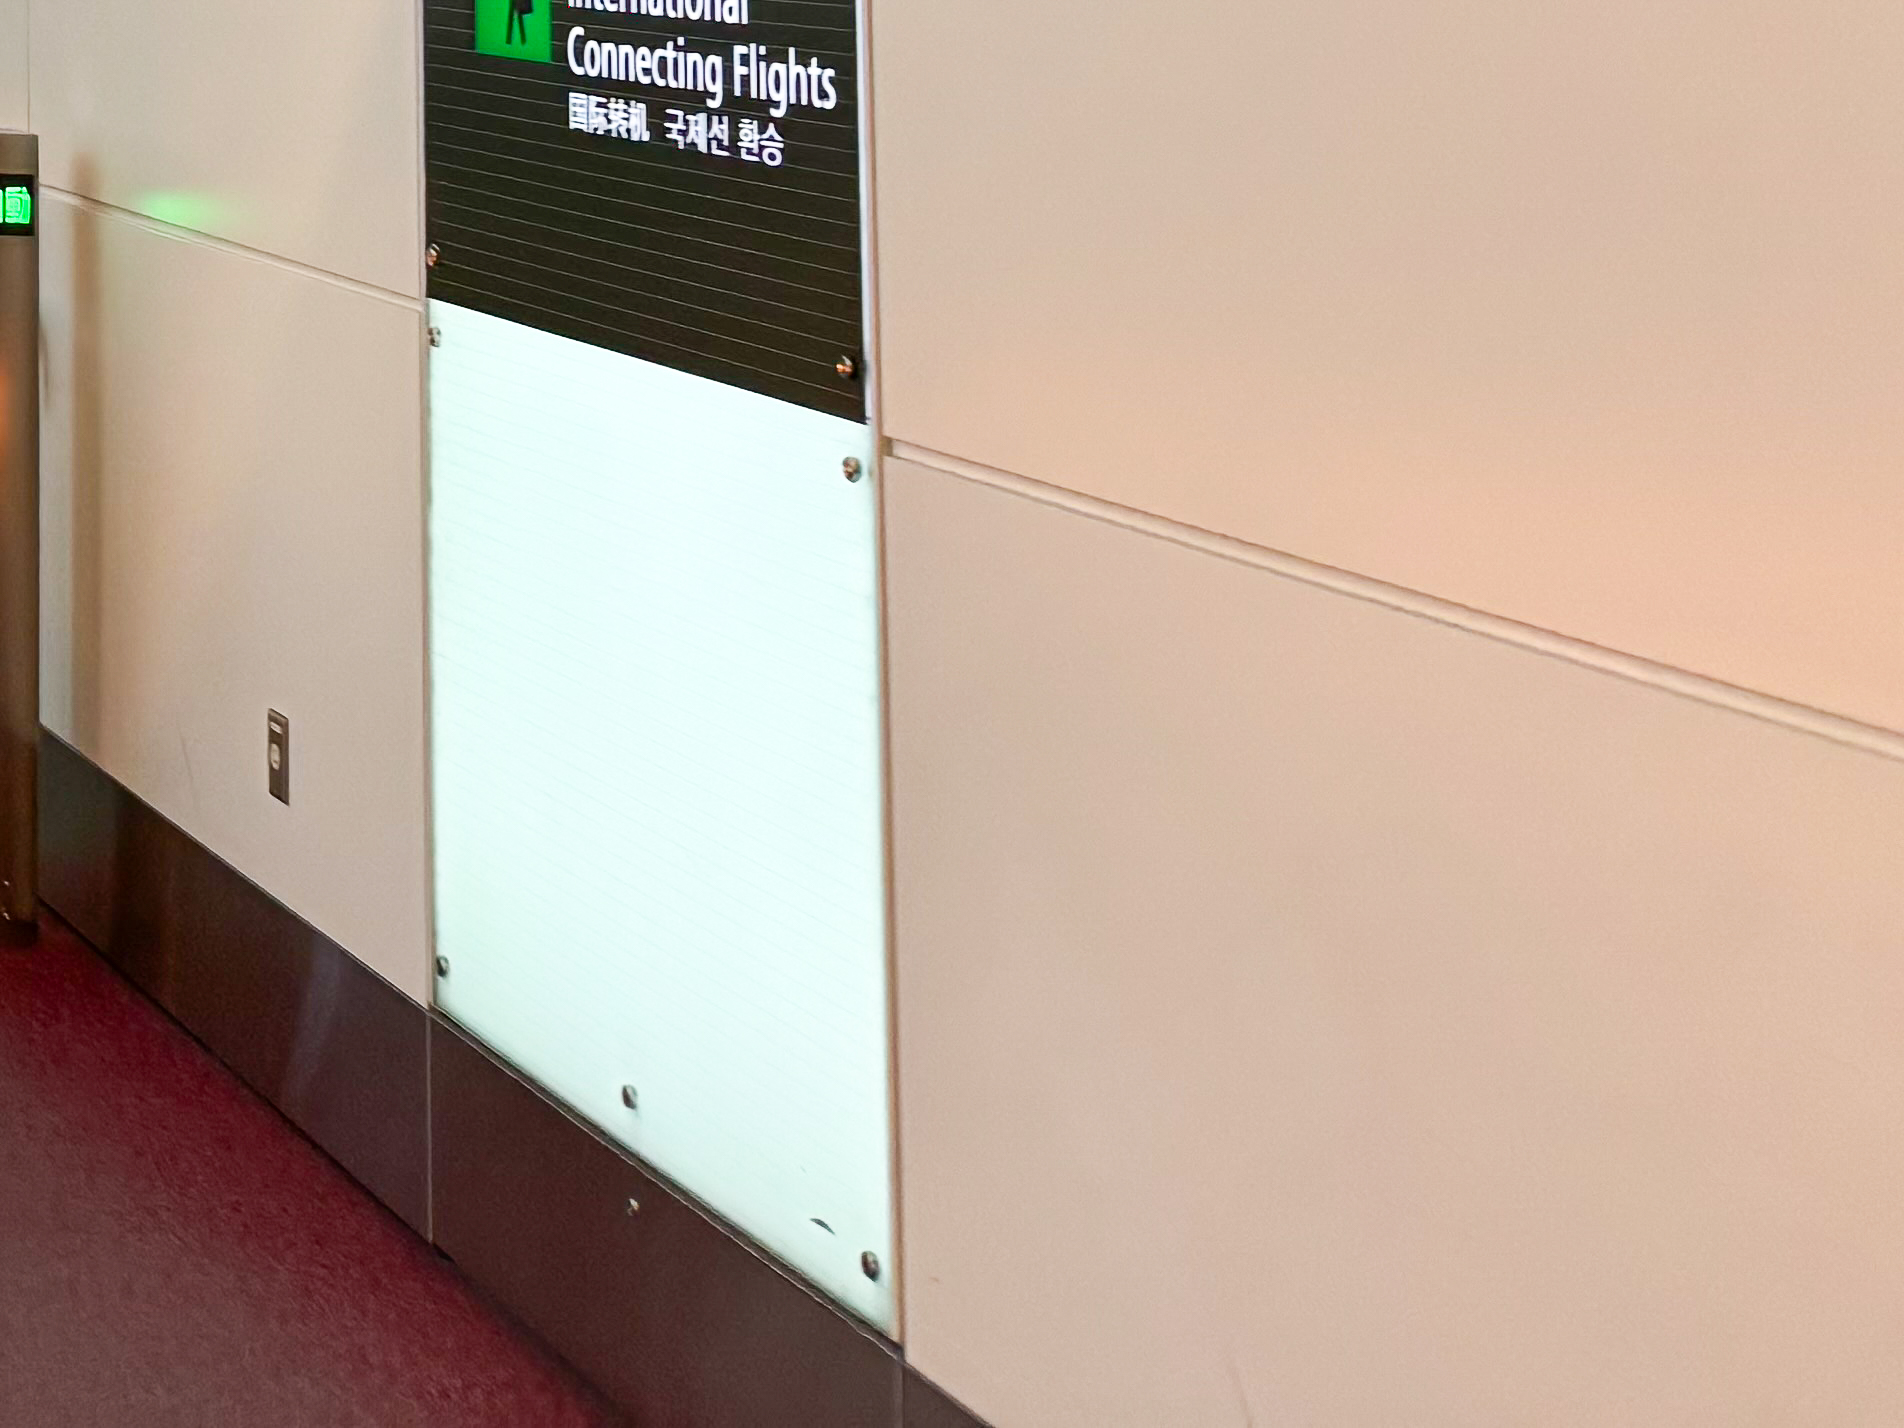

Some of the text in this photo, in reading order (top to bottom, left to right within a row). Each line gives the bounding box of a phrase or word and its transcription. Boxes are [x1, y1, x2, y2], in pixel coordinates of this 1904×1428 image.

[567, 26, 838, 118] Connecting Flights
[663, 108, 785, 167] 국제선 환승
